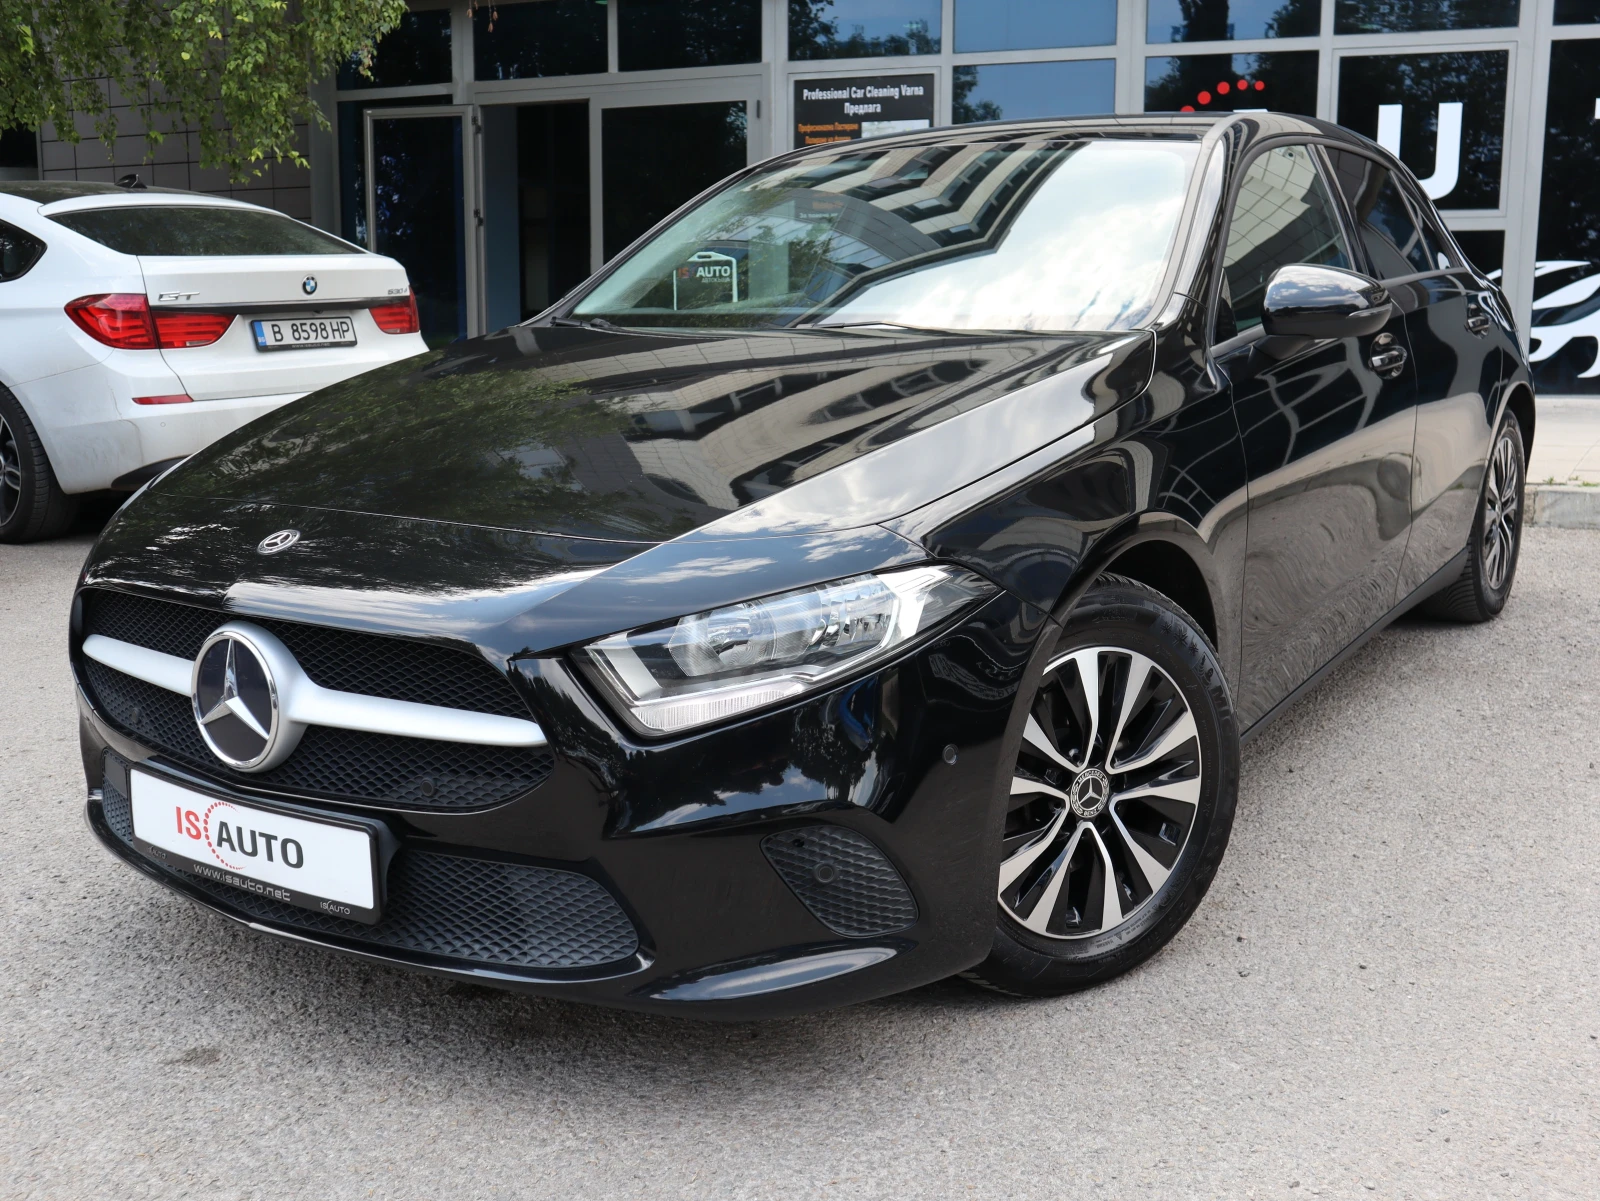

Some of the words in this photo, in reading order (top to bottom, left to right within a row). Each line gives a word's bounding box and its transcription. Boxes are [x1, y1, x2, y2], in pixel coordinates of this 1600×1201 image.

[803, 88, 850, 101] Professional
[851, 86, 865, 98] Car
[866, 85, 899, 99] Cleaning
[901, 84, 924, 96] Varna
[844, 102, 881, 116] Предлага
[696, 265, 731, 278] AUTO
[158, 290, 201, 301] GT
[271, 323, 284, 343] B
[290, 322, 329, 341] 8598
[329, 321, 350, 339] HP
[175, 806, 202, 841] IS
[216, 820, 304, 869] AUTO
[193, 863, 291, 902] www.isauto.net
